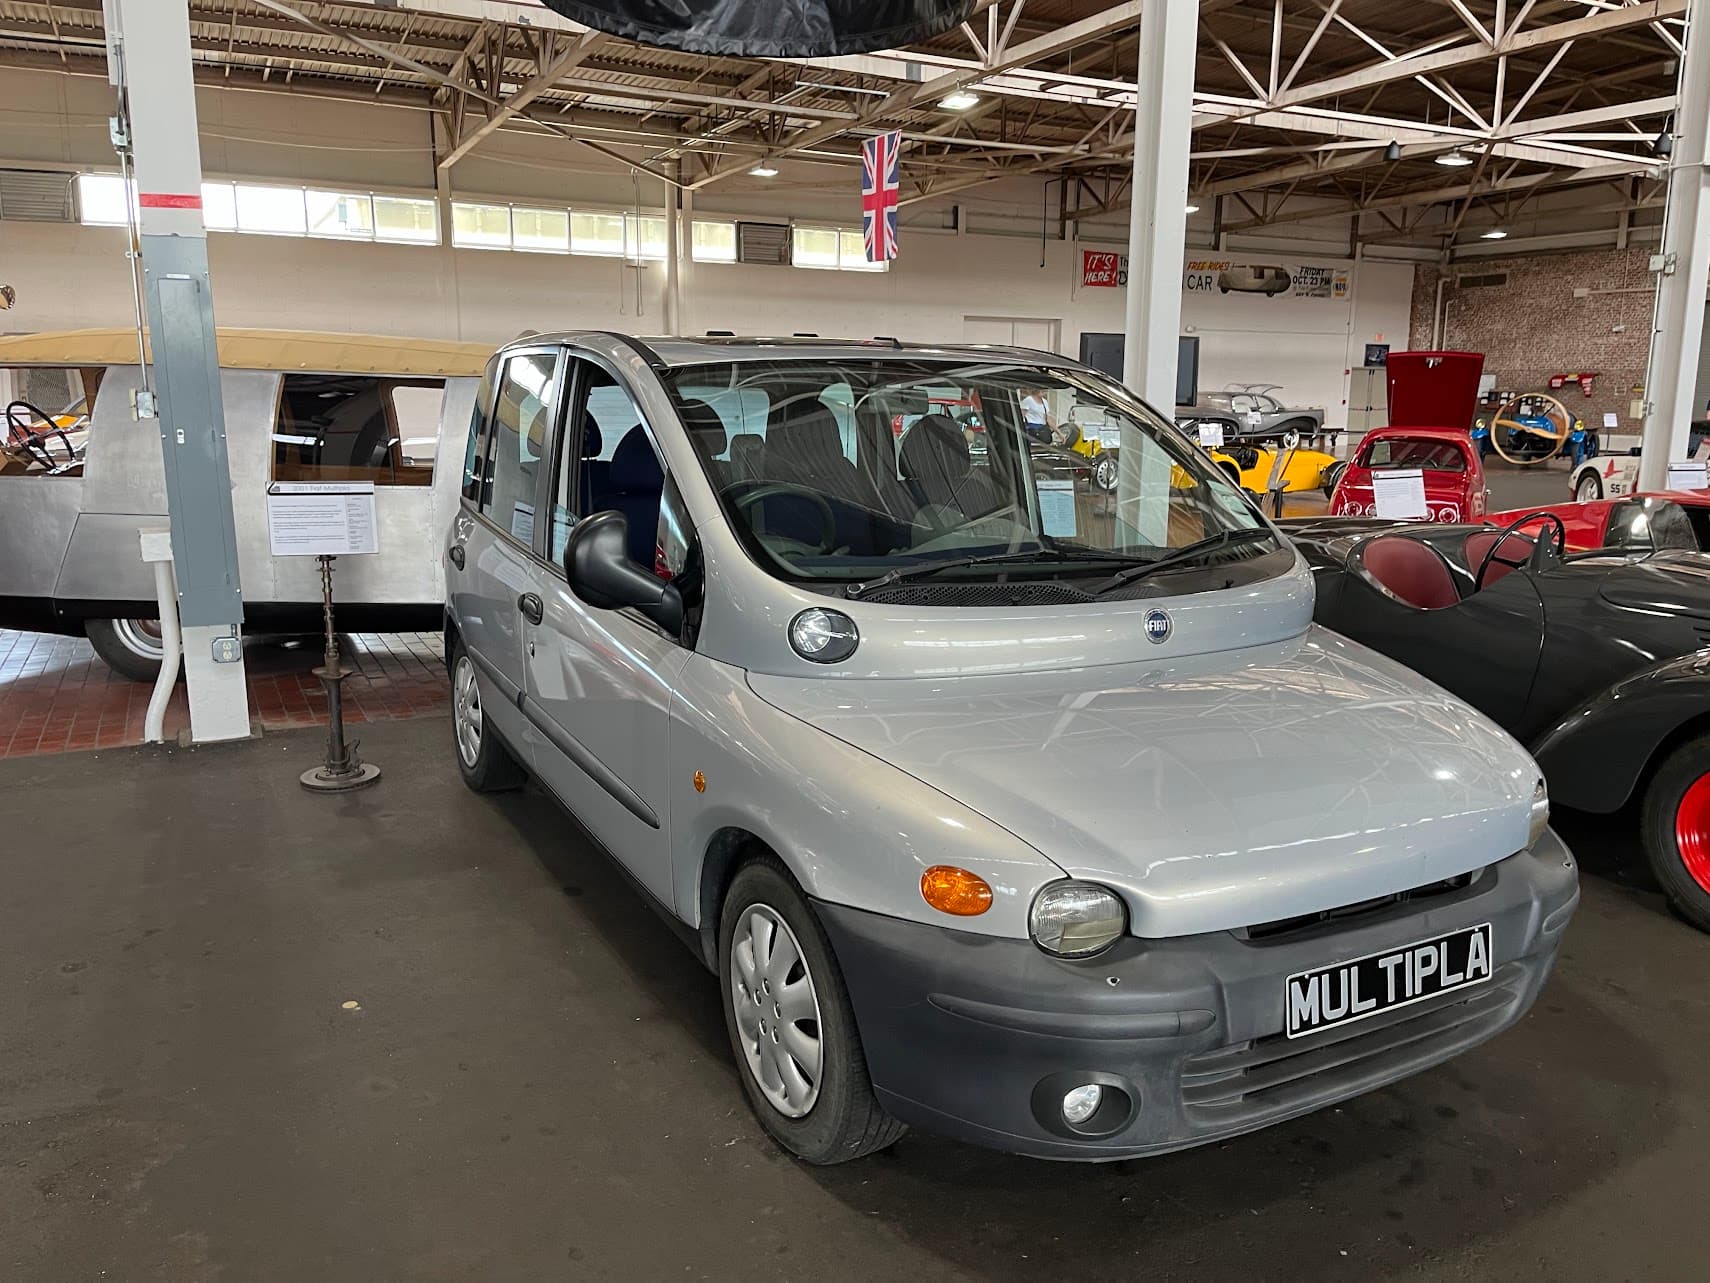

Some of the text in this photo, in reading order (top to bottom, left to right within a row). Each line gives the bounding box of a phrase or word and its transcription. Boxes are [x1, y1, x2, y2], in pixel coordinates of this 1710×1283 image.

[1088, 254, 1114, 269] IT'S
[1084, 270, 1117, 285] HERE!
[1300, 266, 1325, 276] FRIDAY
[1187, 274, 1213, 291] CAR
[1293, 275, 1309, 285] OCT.
[1309, 276, 1318, 286] 23
[1148, 620, 1167, 632] FIAT
[1290, 931, 1489, 1030] MULTIPLA
